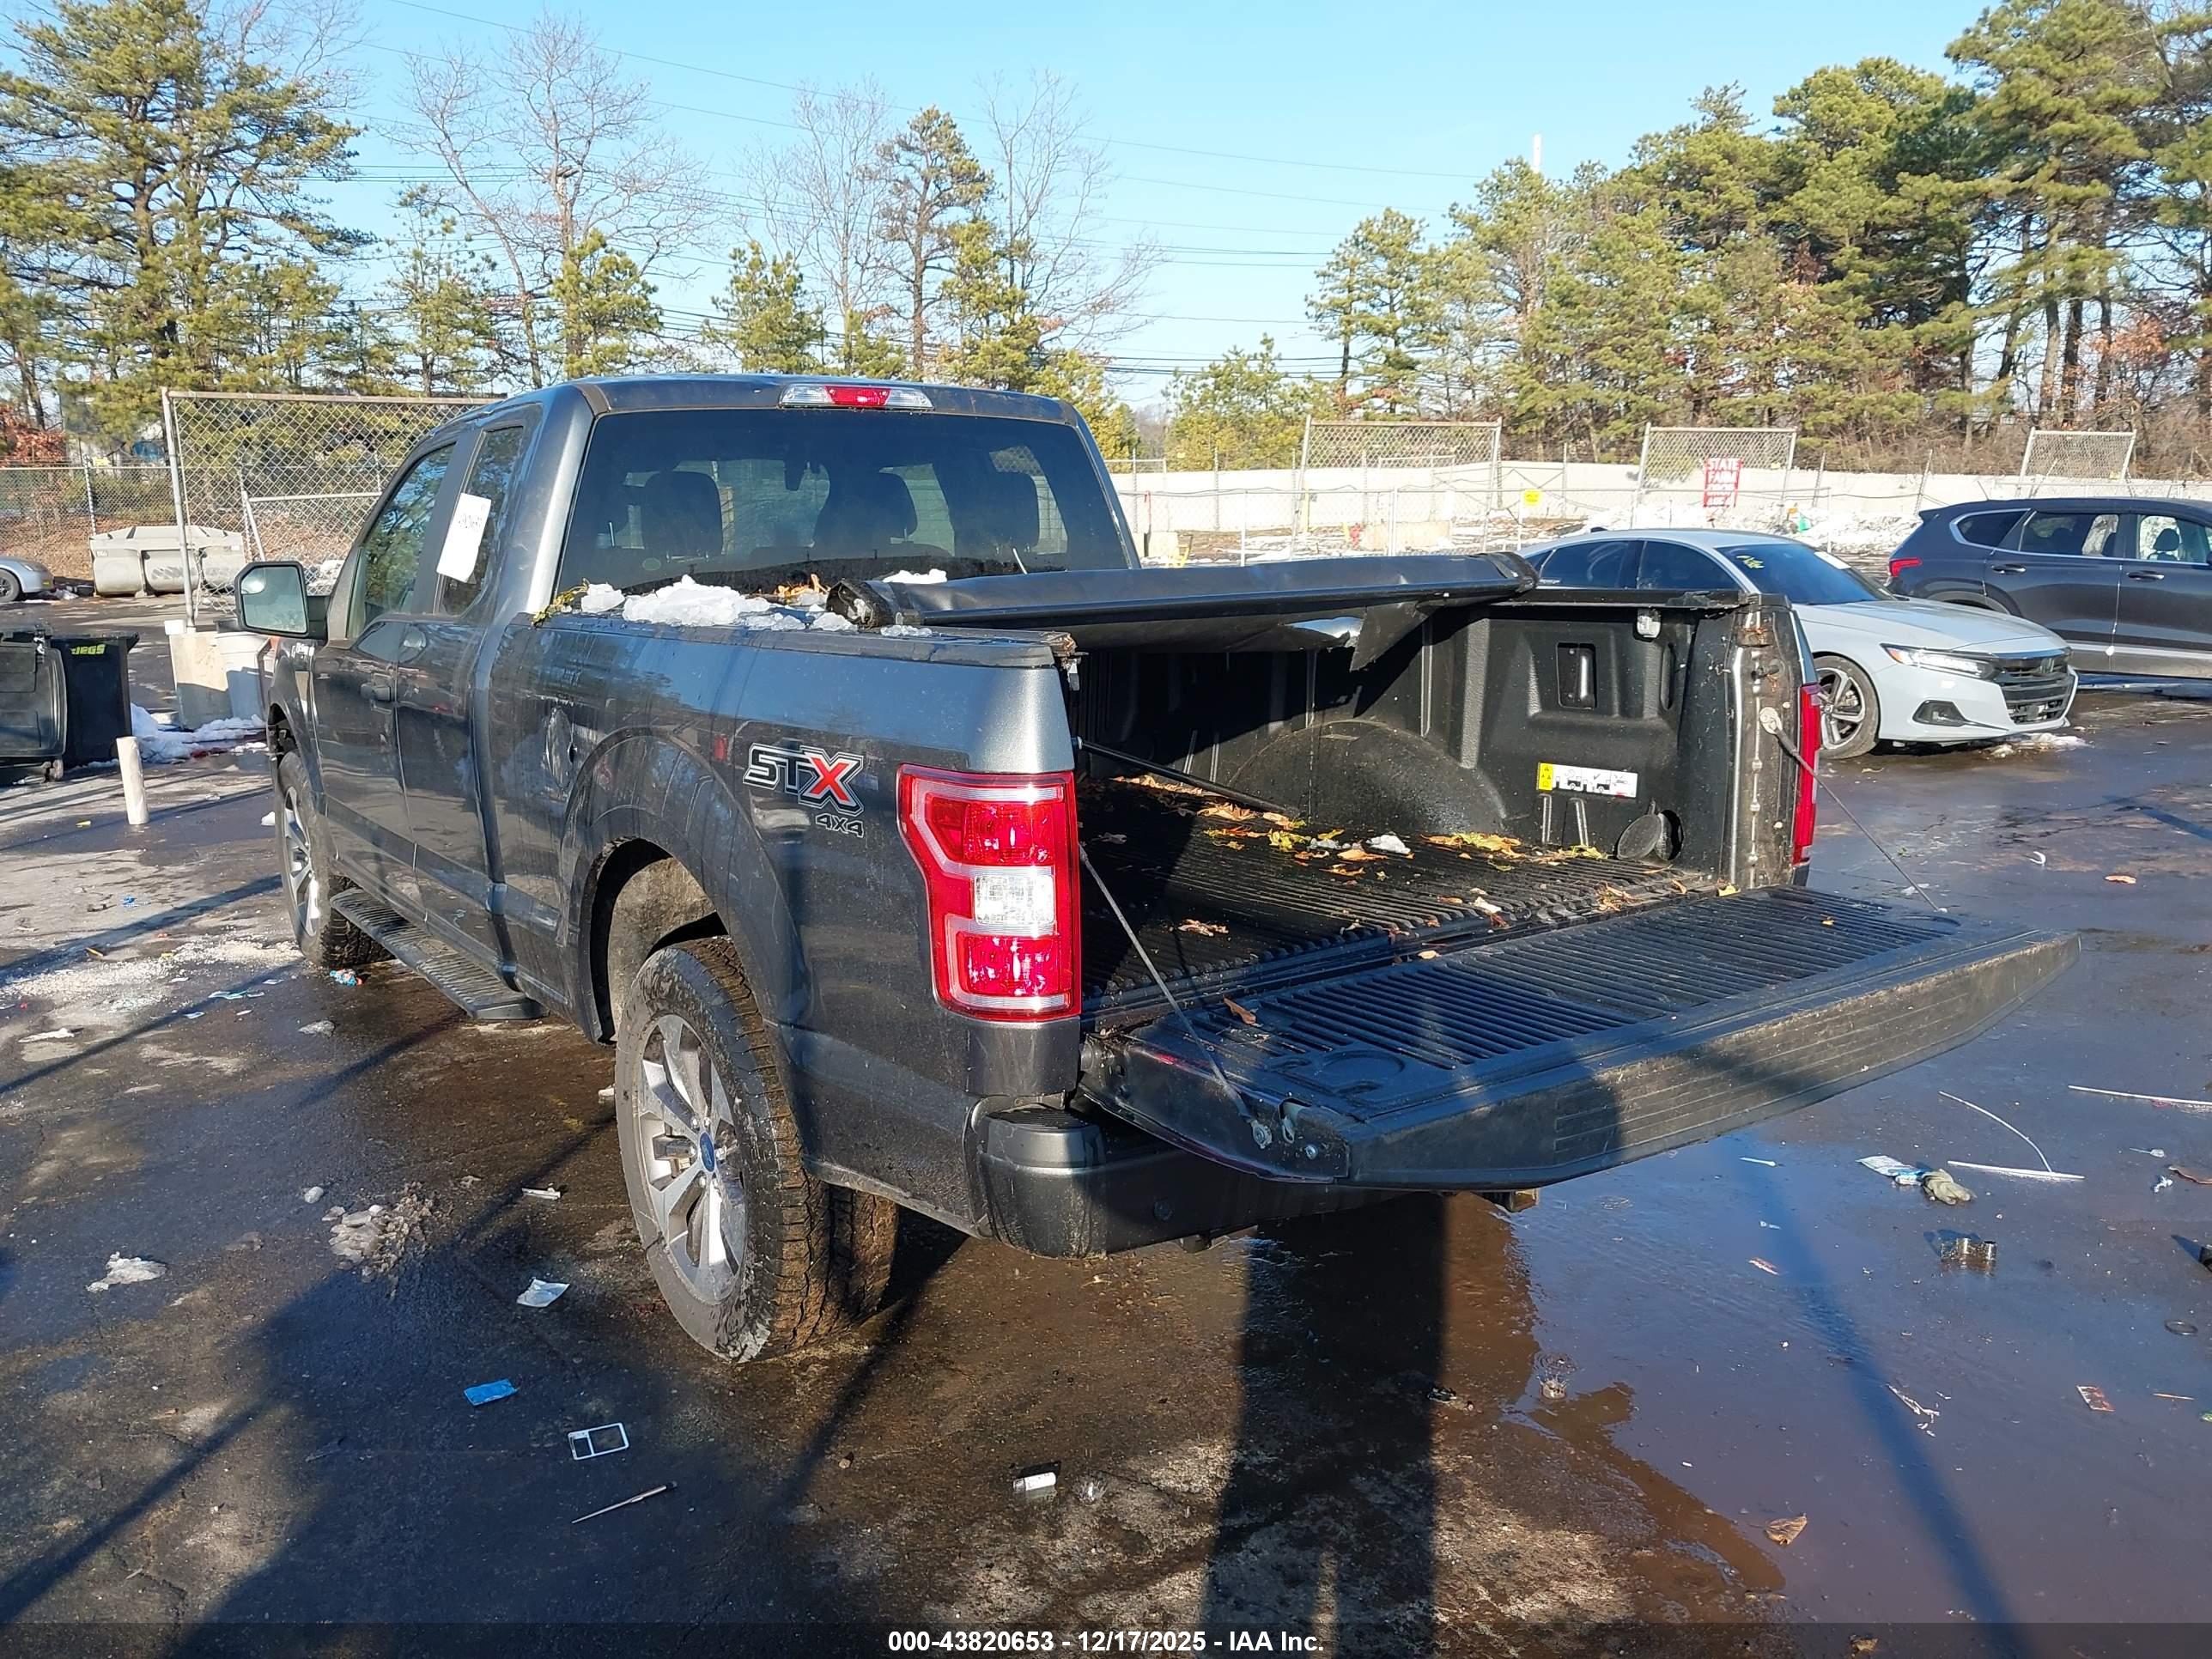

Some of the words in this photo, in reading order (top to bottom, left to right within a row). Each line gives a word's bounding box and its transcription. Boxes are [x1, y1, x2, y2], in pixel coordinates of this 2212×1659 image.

[1707, 457, 1740, 471] STATE
[1708, 471, 1736, 483] FARM
[70, 643, 106, 655] JEGS
[743, 743, 864, 817] STX
